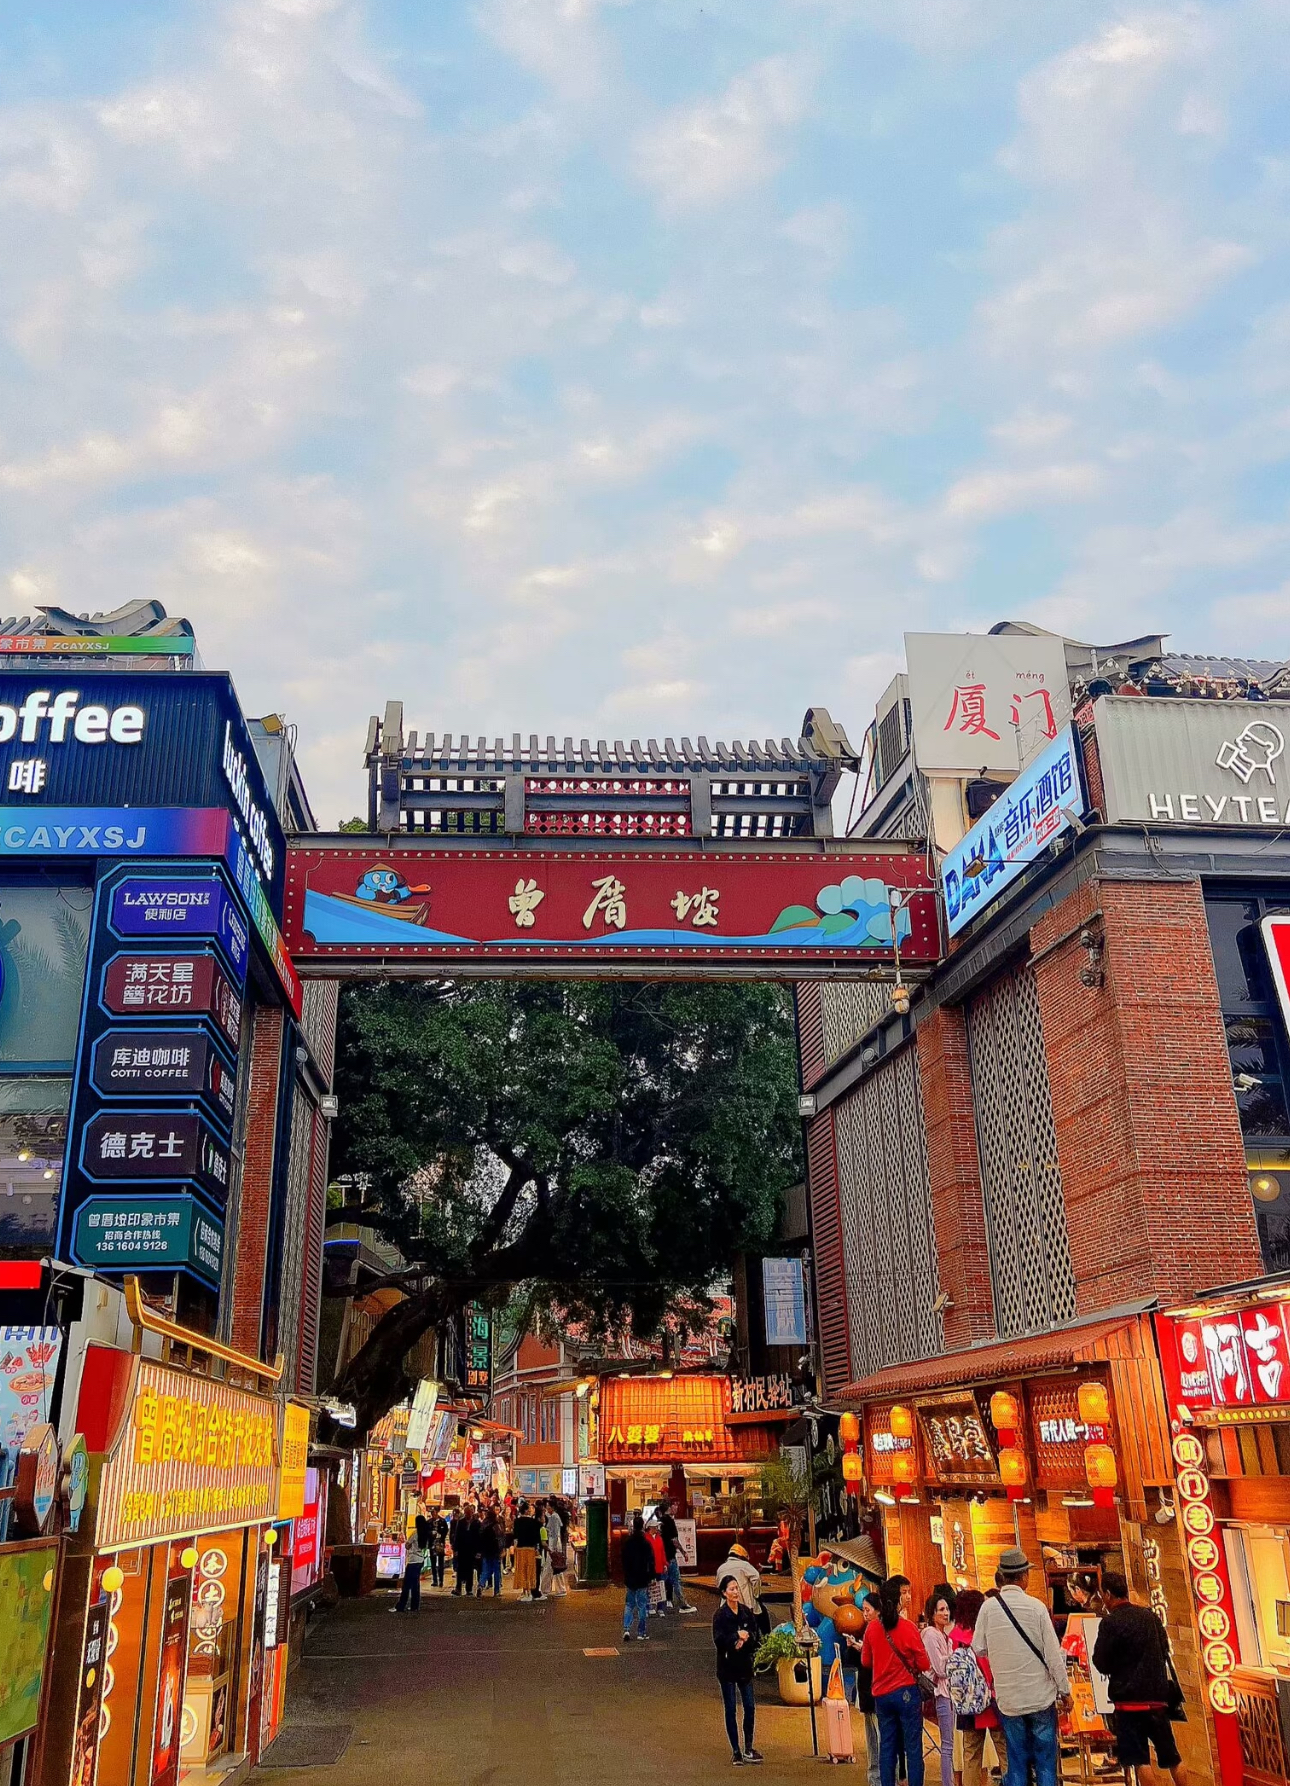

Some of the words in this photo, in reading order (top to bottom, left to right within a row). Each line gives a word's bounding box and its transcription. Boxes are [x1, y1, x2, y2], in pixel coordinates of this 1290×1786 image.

[52, 642, 110, 650] ZCAYXSJ
[944, 683, 1058, 740] 厦门
[8, 759, 46, 794] 啡
[1003, 750, 1073, 850] 音乐酒馆
[0, 826, 147, 849] CAYXSJ
[123, 893, 204, 906] LAWSON
[508, 874, 720, 930] 曾厝垵
[144, 908, 187, 921] 便利店
[124, 963, 195, 983] 满天星
[122, 985, 193, 1005] 簪花坊
[111, 1047, 191, 1067] 库迪咖啡
[110, 1070, 140, 1078] COTTI
[145, 1069, 189, 1078] COFFEE
[100, 1132, 185, 1159] 德克士
[96, 1242, 115, 1251] 136
[116, 1242, 140, 1251] 1604
[143, 1241, 168, 1251] 9128
[732, 1372, 793, 1413] 新村民驿站
[608, 1424, 661, 1445] 八婆婆
[1177, 1437, 1237, 1709] 厦门老字号伴手礼
